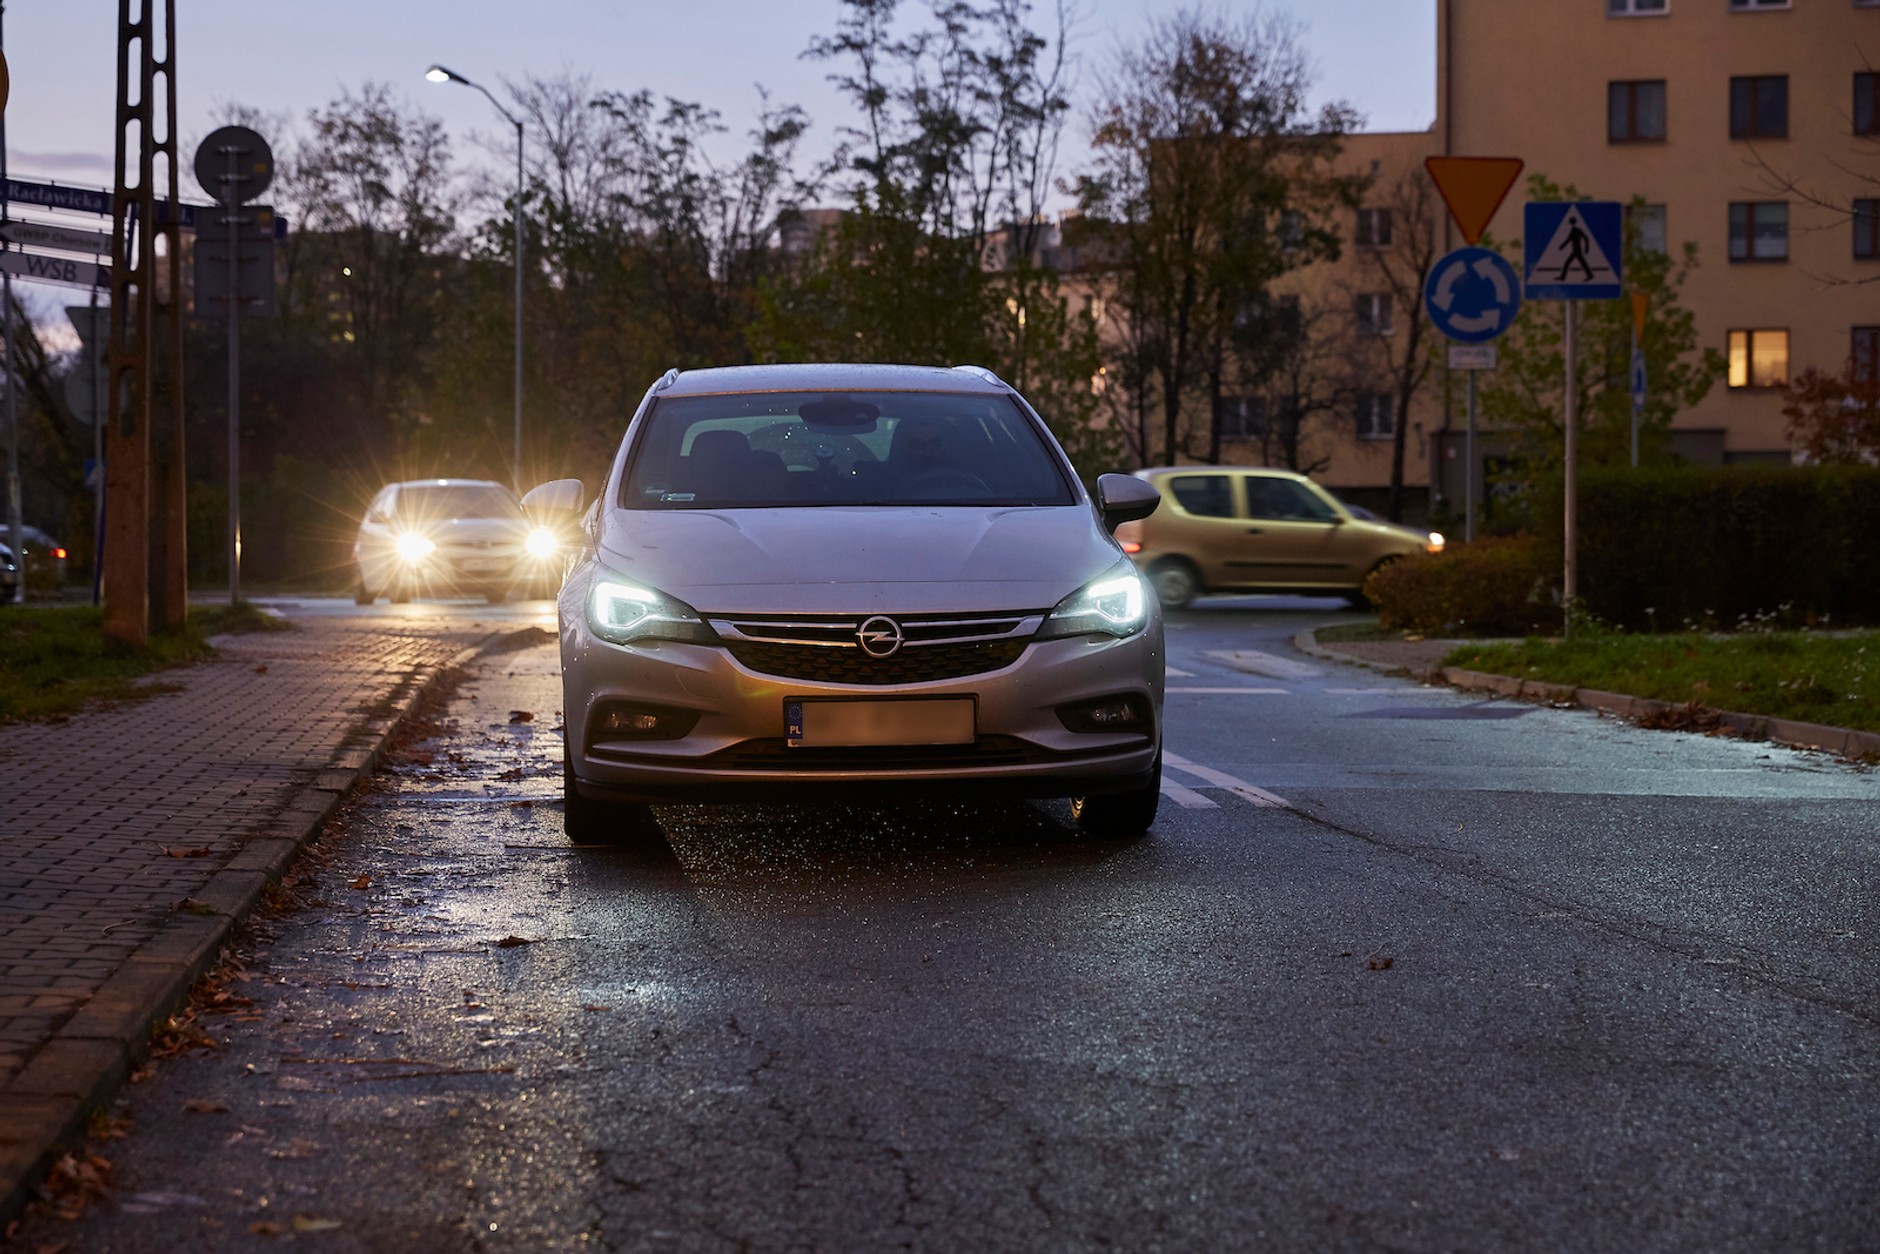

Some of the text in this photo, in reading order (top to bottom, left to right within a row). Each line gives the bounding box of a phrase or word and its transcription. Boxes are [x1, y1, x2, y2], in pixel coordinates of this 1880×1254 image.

[8, 183, 103, 210] Racławicka
[26, 255, 77, 282] WSB
[789, 725, 802, 735] PL
